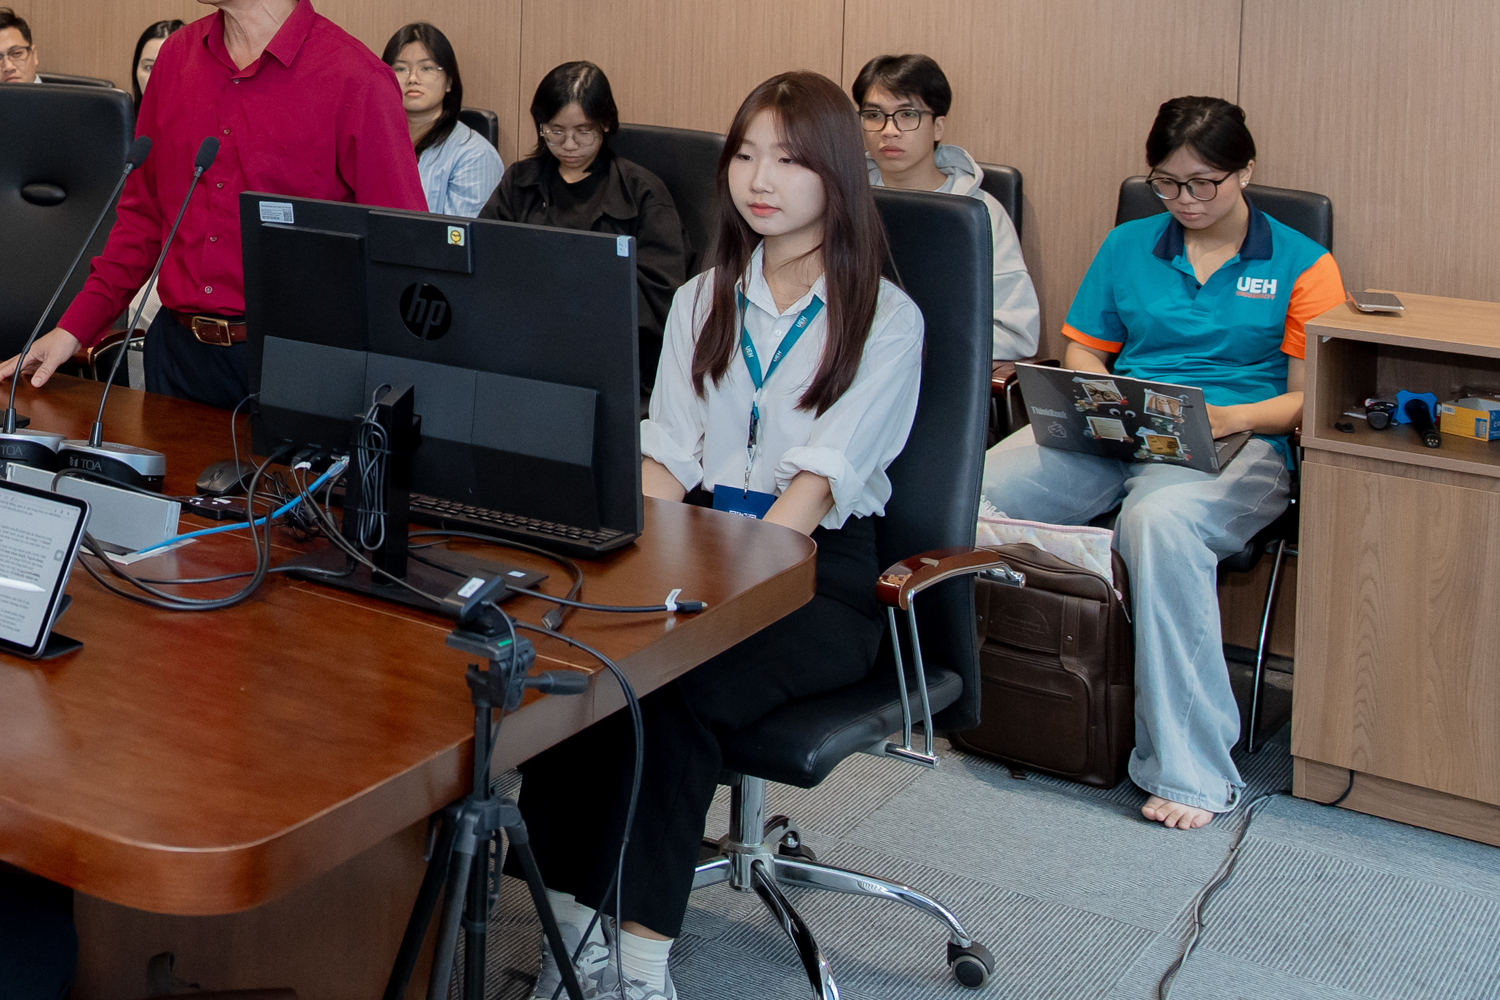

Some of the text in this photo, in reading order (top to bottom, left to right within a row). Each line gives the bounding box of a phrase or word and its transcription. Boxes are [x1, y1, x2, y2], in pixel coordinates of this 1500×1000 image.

[1236, 276, 1278, 295] UEH
[404, 282, 448, 340] hp
[795, 315, 807, 328] UEH
[745, 345, 755, 358] UEH
[772, 350, 782, 363] UEH
[0, 445, 23, 456] TOA
[80, 458, 102, 471] TOA
